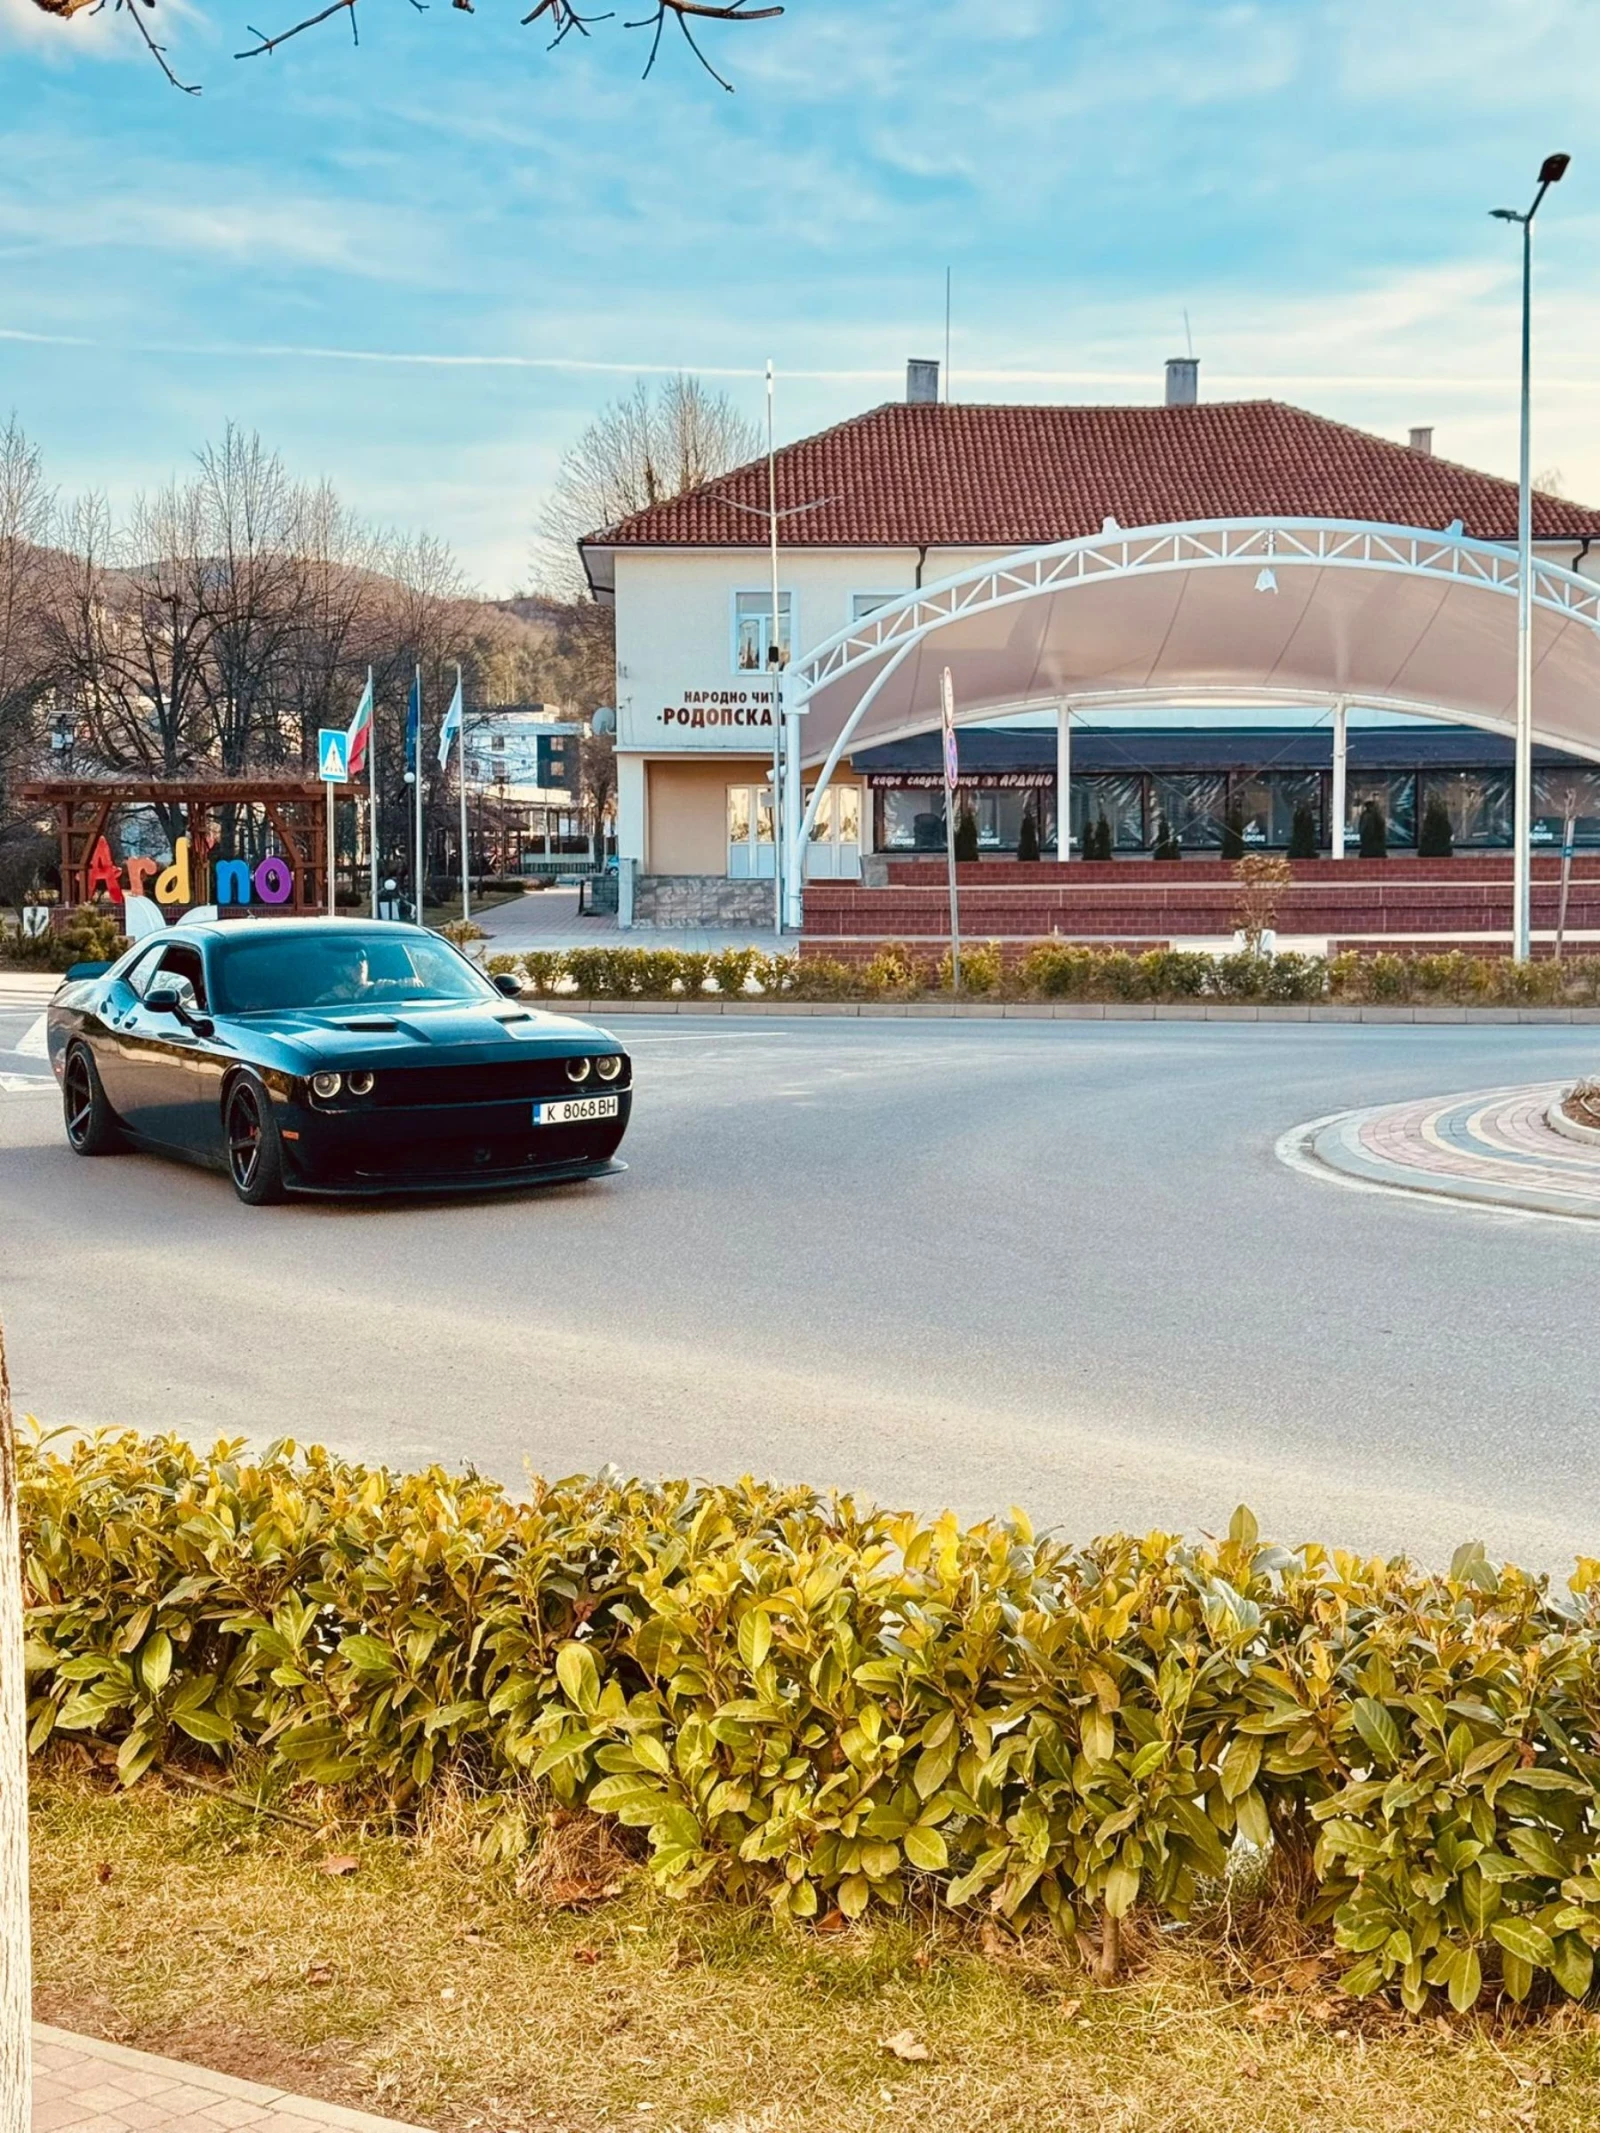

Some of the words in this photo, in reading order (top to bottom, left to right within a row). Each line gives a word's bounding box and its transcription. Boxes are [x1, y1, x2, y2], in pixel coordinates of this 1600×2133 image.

[684, 691, 748, 705] НАРОДНО
[663, 708, 773, 729] РОДОПСКА
[872, 775, 902, 788] кафе
[907, 775, 980, 788] сладкаица
[999, 774, 1054, 787] АРДИНО
[87, 835, 293, 904] Ardno
[547, 1105, 556, 1121] K
[563, 1101, 596, 1119] 8068
